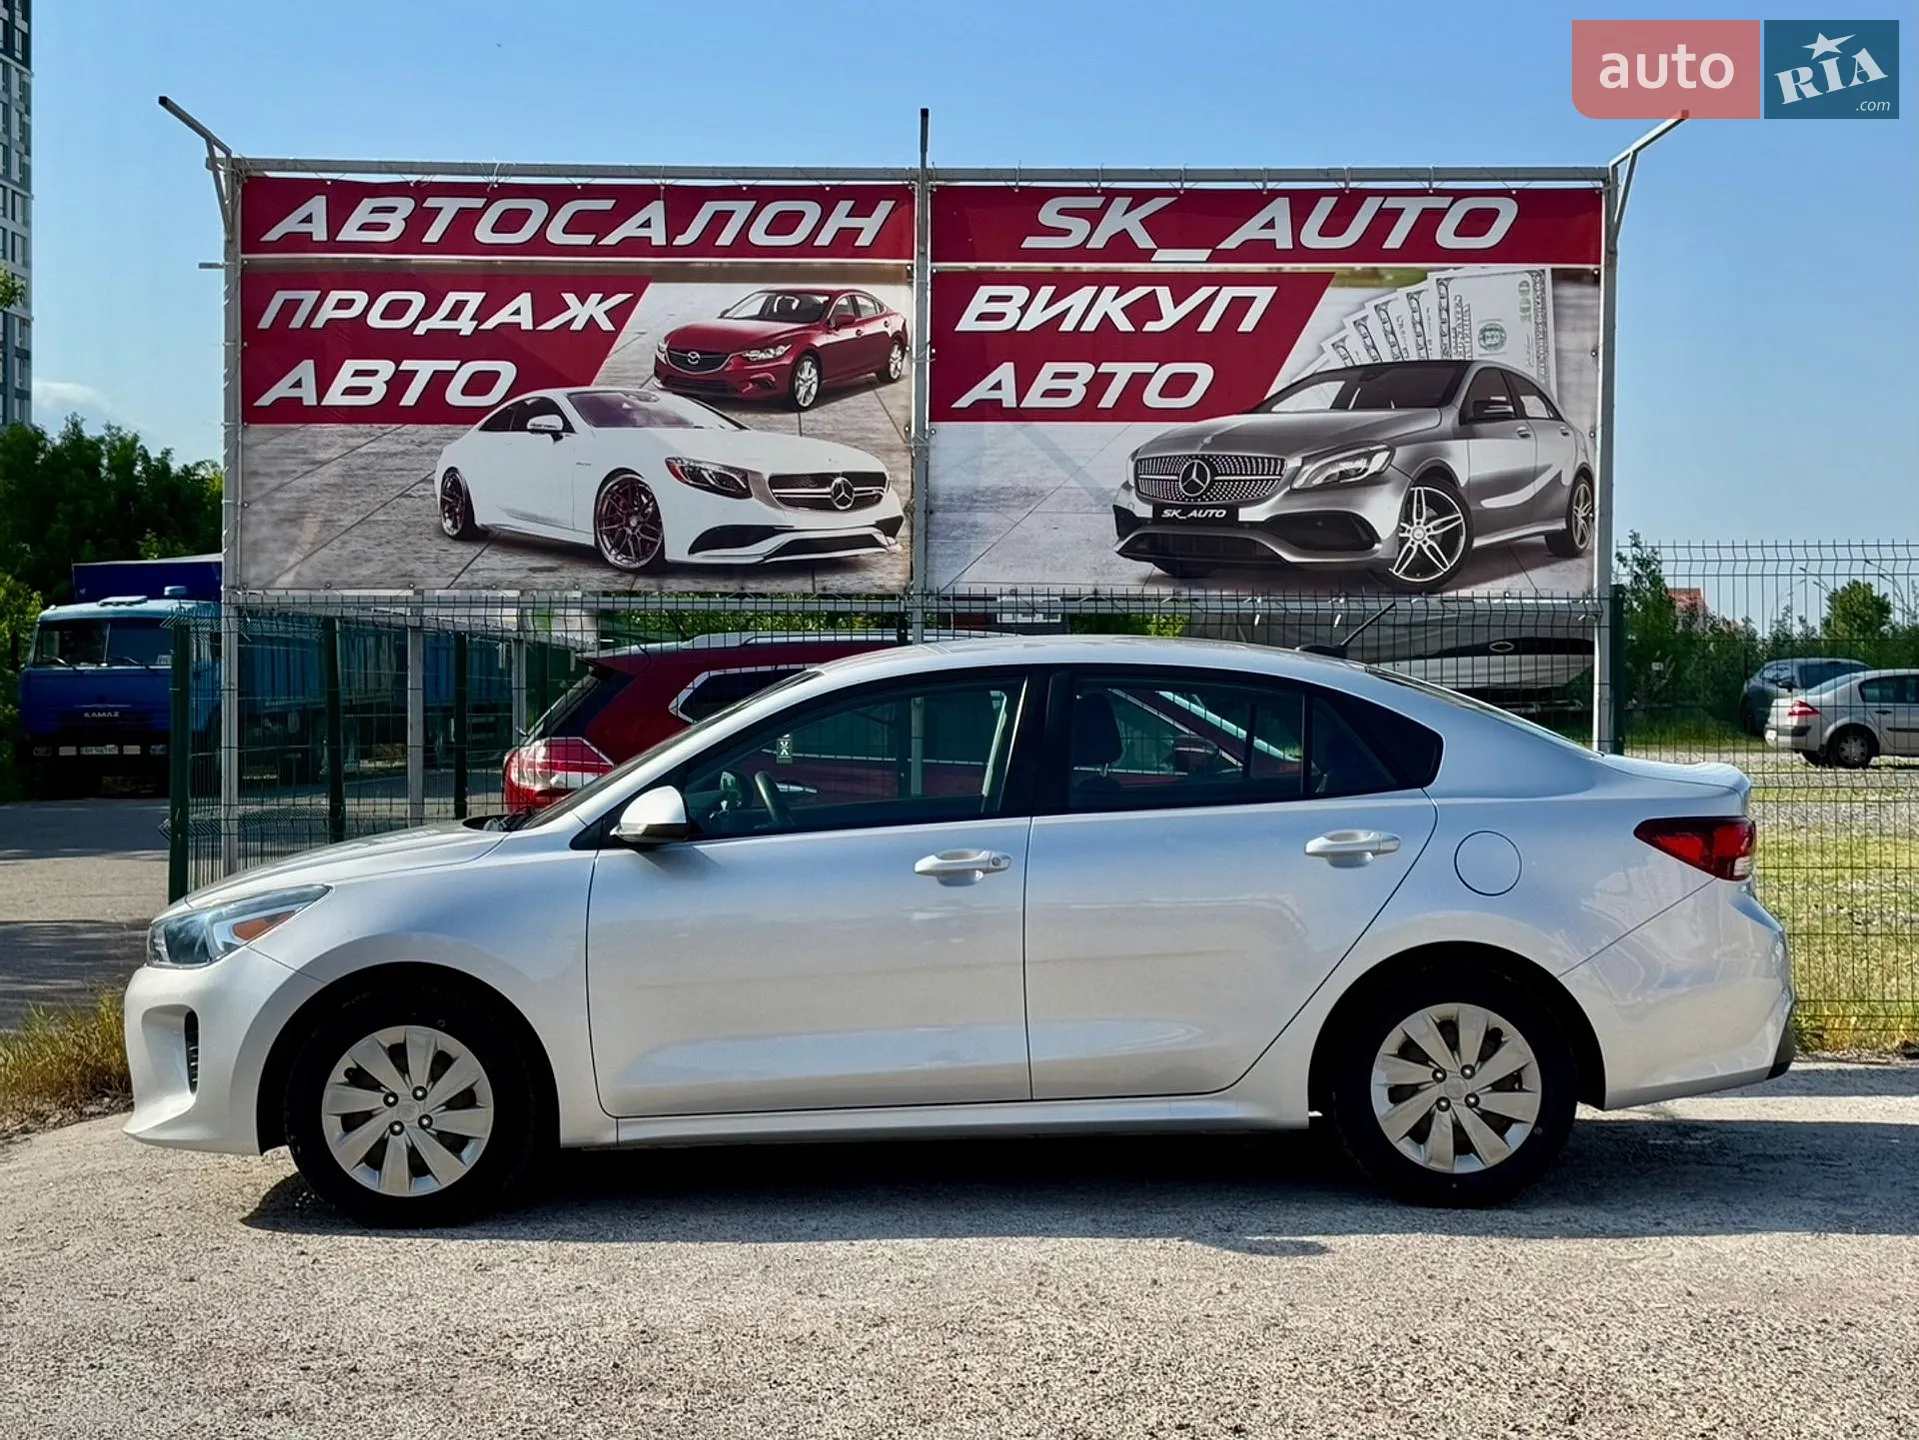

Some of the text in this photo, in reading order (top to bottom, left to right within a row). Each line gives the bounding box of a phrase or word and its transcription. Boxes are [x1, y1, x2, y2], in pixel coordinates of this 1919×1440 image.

[259, 195, 897, 246] АВТОСАЛОН
[1020, 196, 1519, 262] SK_AUTO
[257, 290, 634, 336] ПРОДАЖ
[954, 285, 1278, 332] ВИКУП
[253, 359, 517, 407] АВТО
[951, 361, 1215, 409] АВТО
[1161, 508, 1227, 519] SK_AUTO
